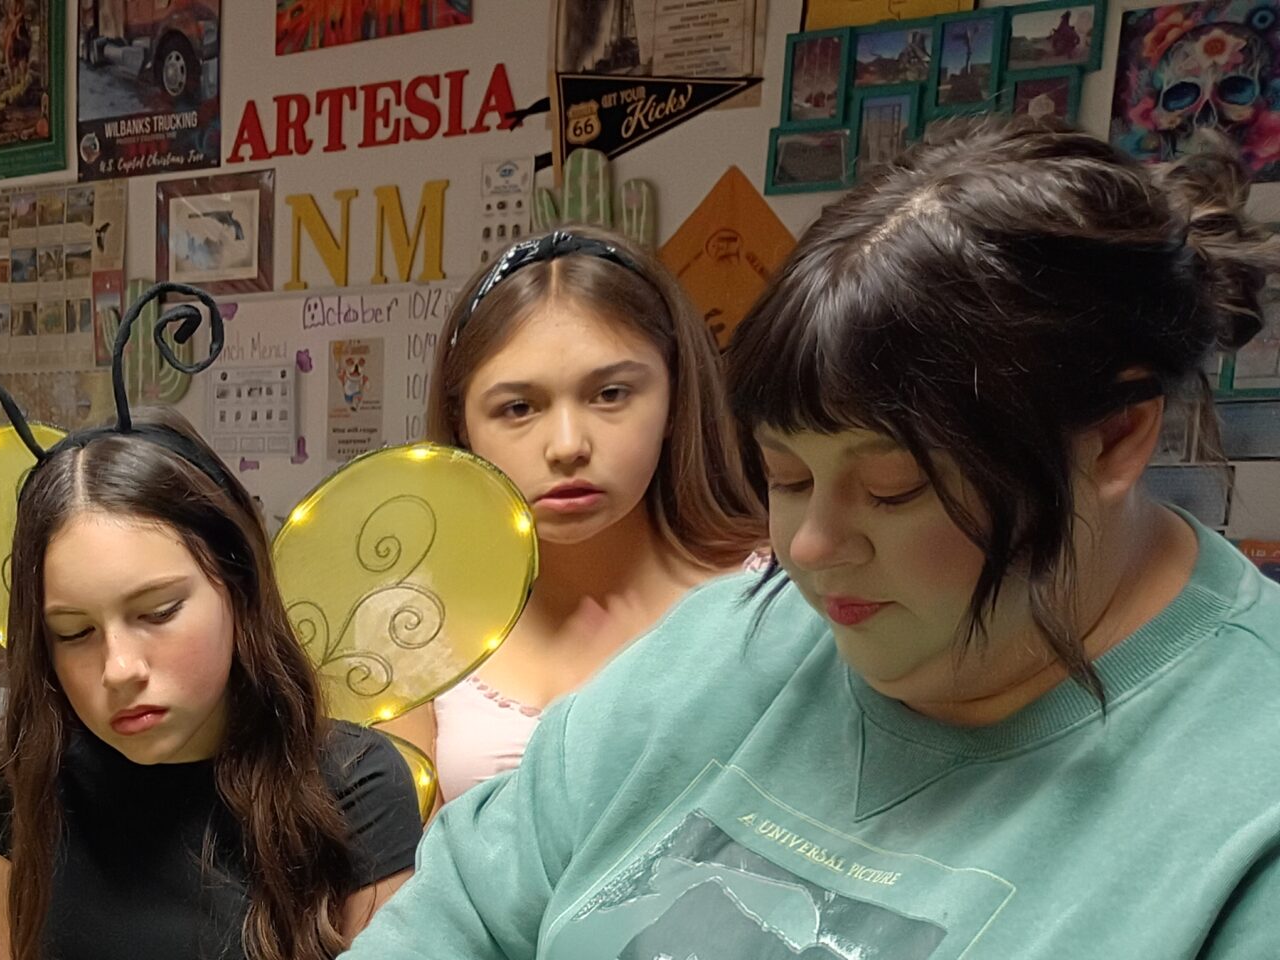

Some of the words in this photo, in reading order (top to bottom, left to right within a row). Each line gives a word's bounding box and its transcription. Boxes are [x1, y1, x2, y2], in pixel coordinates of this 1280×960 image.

[104, 117, 151, 138] WILBANKS
[152, 111, 198, 133] TRUCKING
[226, 63, 524, 163] ARTESIA
[621, 84, 693, 138] Kicks
[572, 118, 595, 138] 66
[250, 332, 288, 360] Menu
[407, 374, 429, 406] 10/
[737, 813, 757, 827] A
[757, 820, 846, 873] UNIVERSAL
[846, 862, 903, 886] PICTURE
